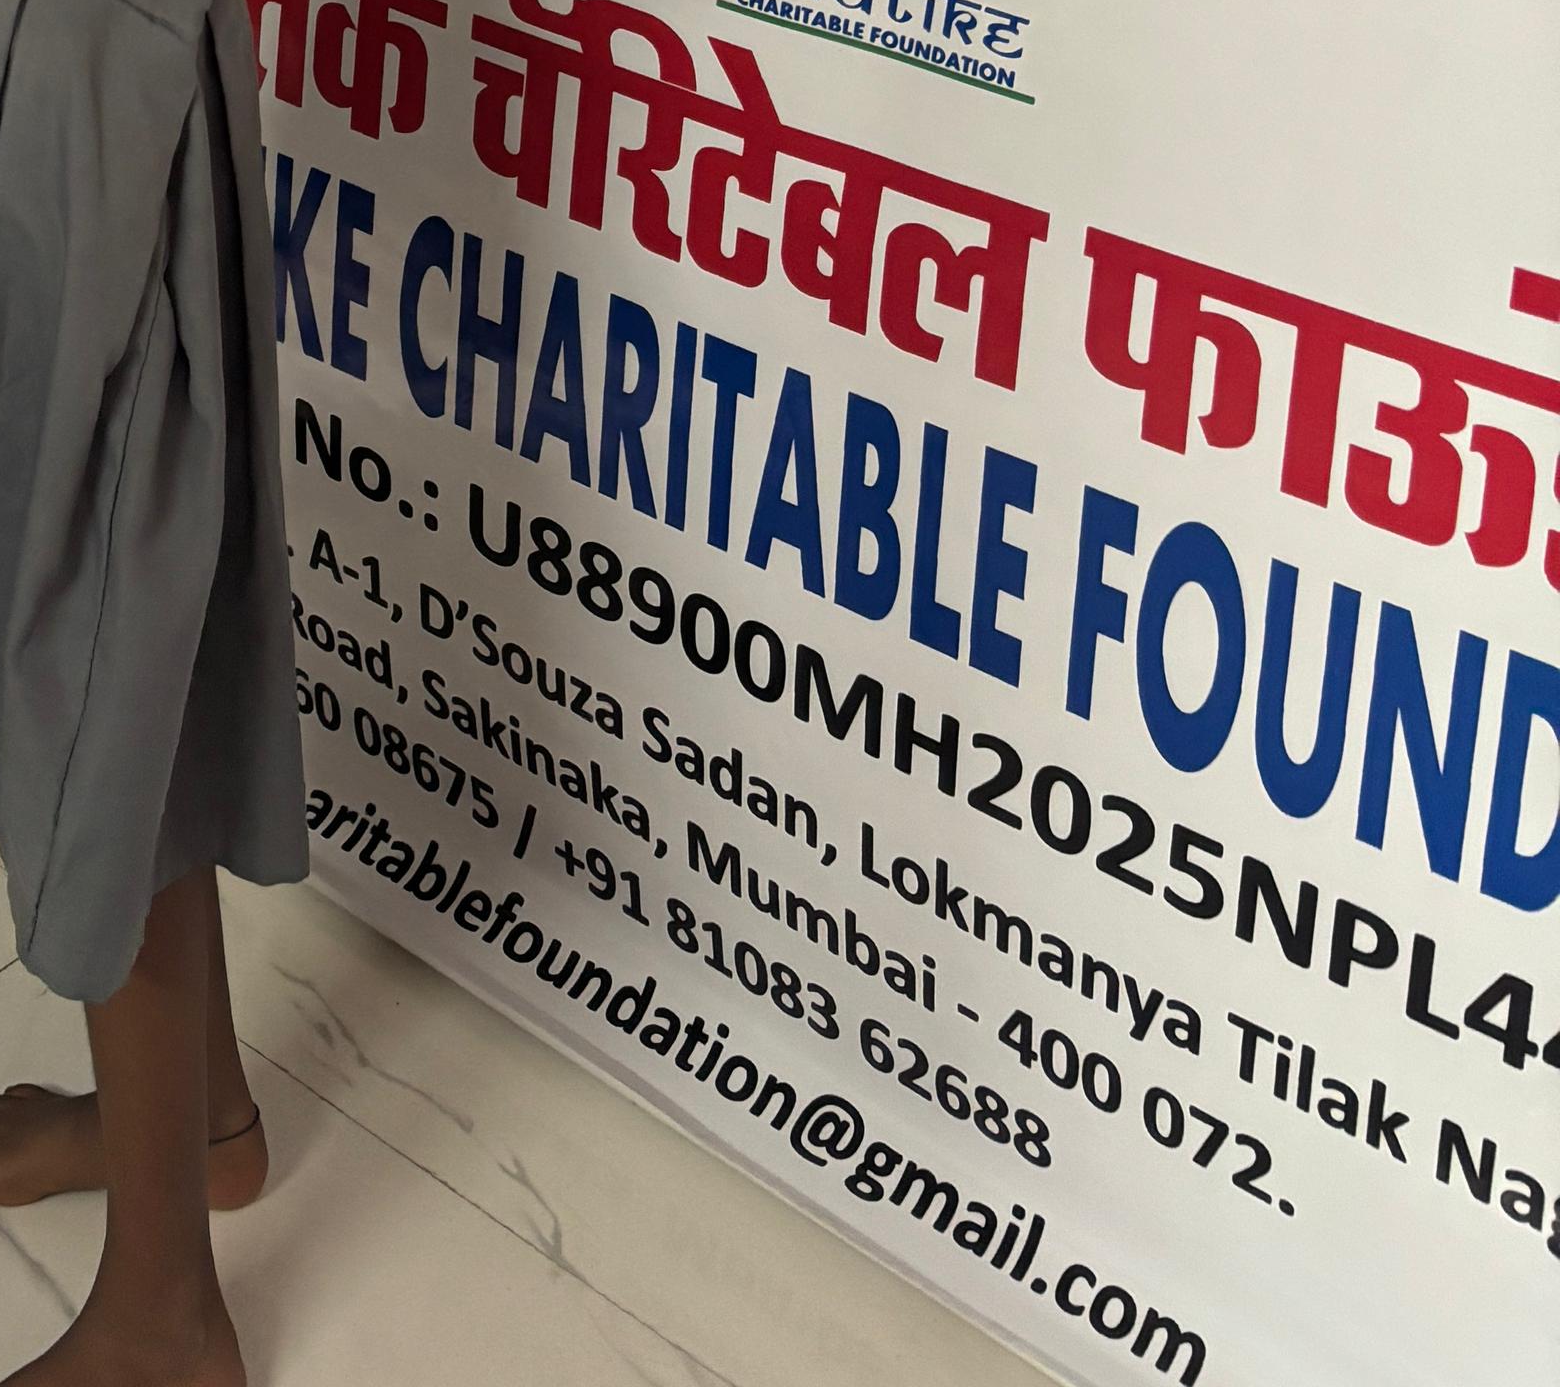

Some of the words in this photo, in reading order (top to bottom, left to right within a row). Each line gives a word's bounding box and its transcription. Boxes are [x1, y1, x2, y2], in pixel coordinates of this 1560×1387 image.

[869, 26, 1017, 89] FOUNDATION
[262, 145, 376, 382] KE
[399, 214, 1040, 689] CHARITABLE
[294, 397, 440, 533] No.:
[466, 481, 1560, 1074] U88900MH2025NPL4
[309, 528, 404, 624] A-1,
[640, 704, 842, 869] Sadan,
[860, 817, 1206, 1059] Lokmanya
[1226, 1009, 1413, 1165] Tilak
[353, 705, 500, 829] 08675
[552, 833, 648, 927] +91
[665, 897, 843, 1041] 81083
[858, 1013, 1055, 1172] 62688
[420, 648, 669, 863] Sakinaka,
[686, 825, 939, 1015] Mumbai
[997, 1004, 1124, 1117] 400
[1140, 1085, 1297, 1219] 072.
